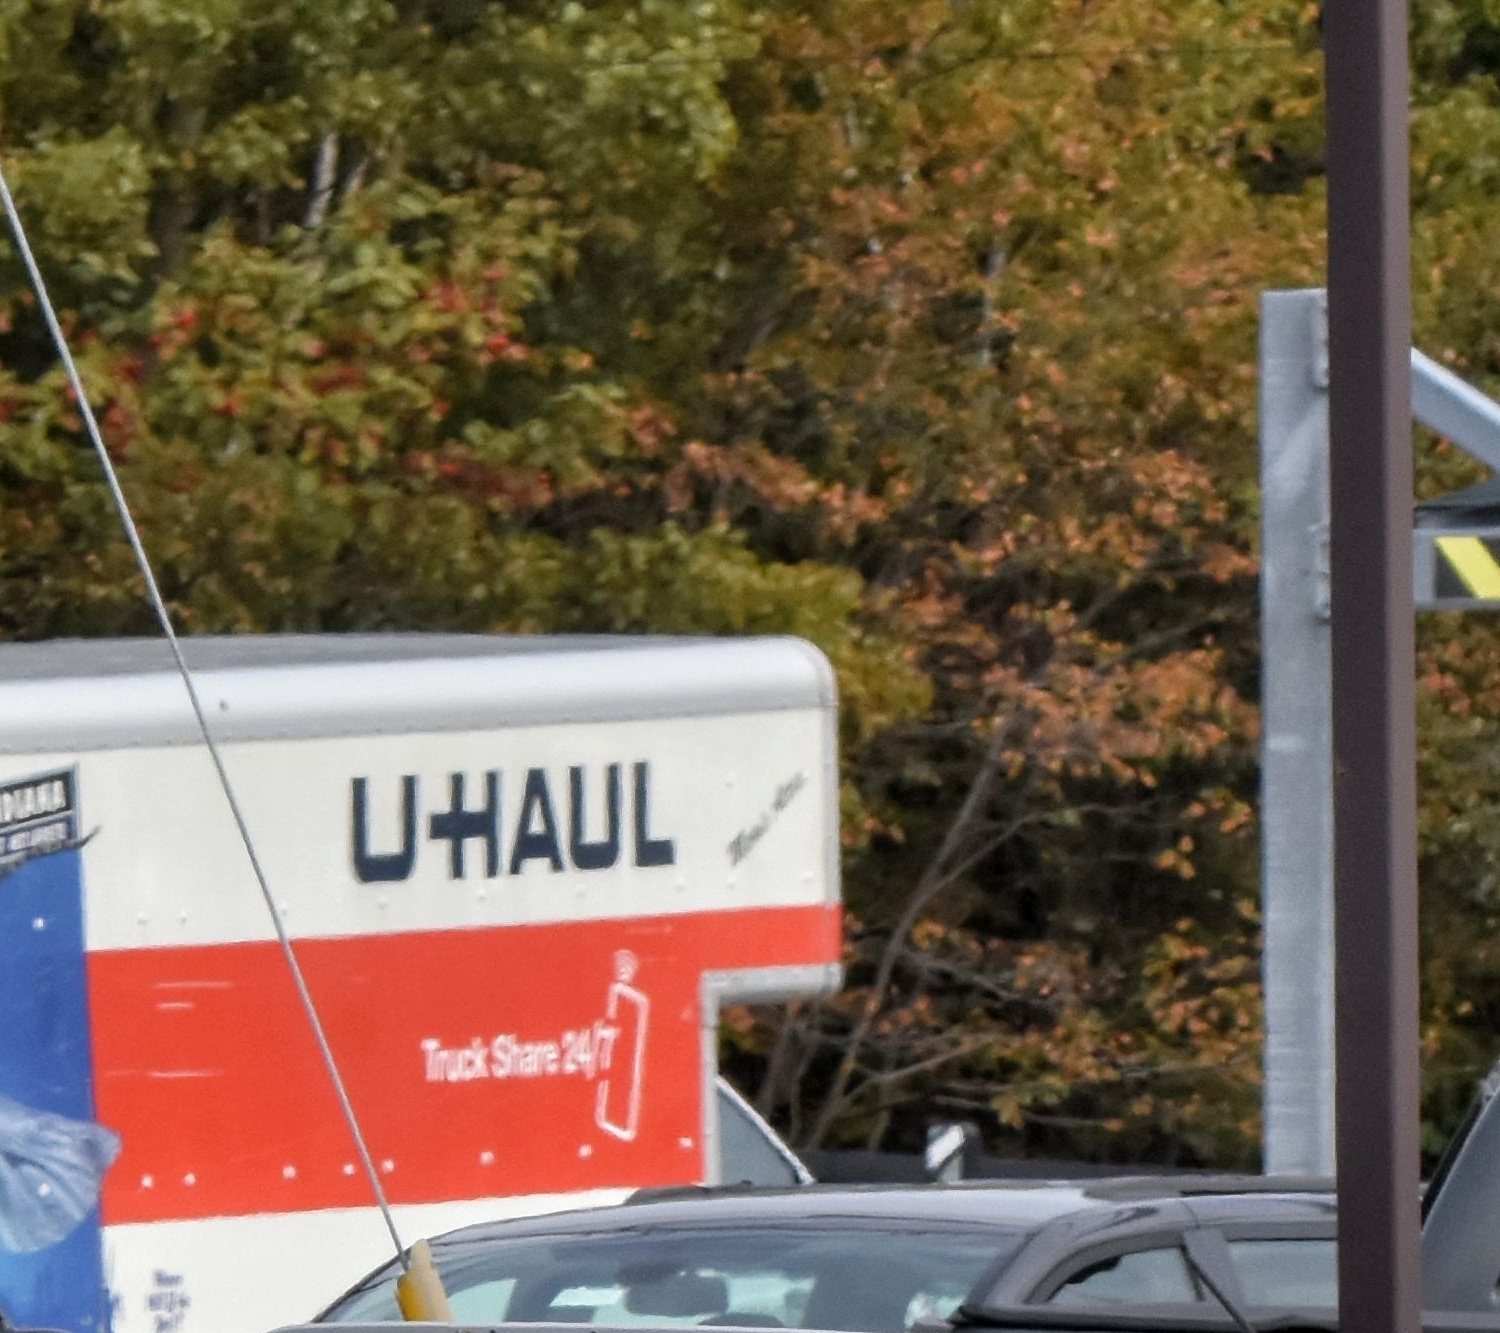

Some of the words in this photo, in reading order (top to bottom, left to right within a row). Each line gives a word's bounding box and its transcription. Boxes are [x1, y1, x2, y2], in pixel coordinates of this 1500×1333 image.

[352, 760, 677, 884] U-HAUL
[420, 1037, 490, 1082] Truck
[491, 1033, 560, 1079] Share
[561, 1018, 621, 1080] 24/7
